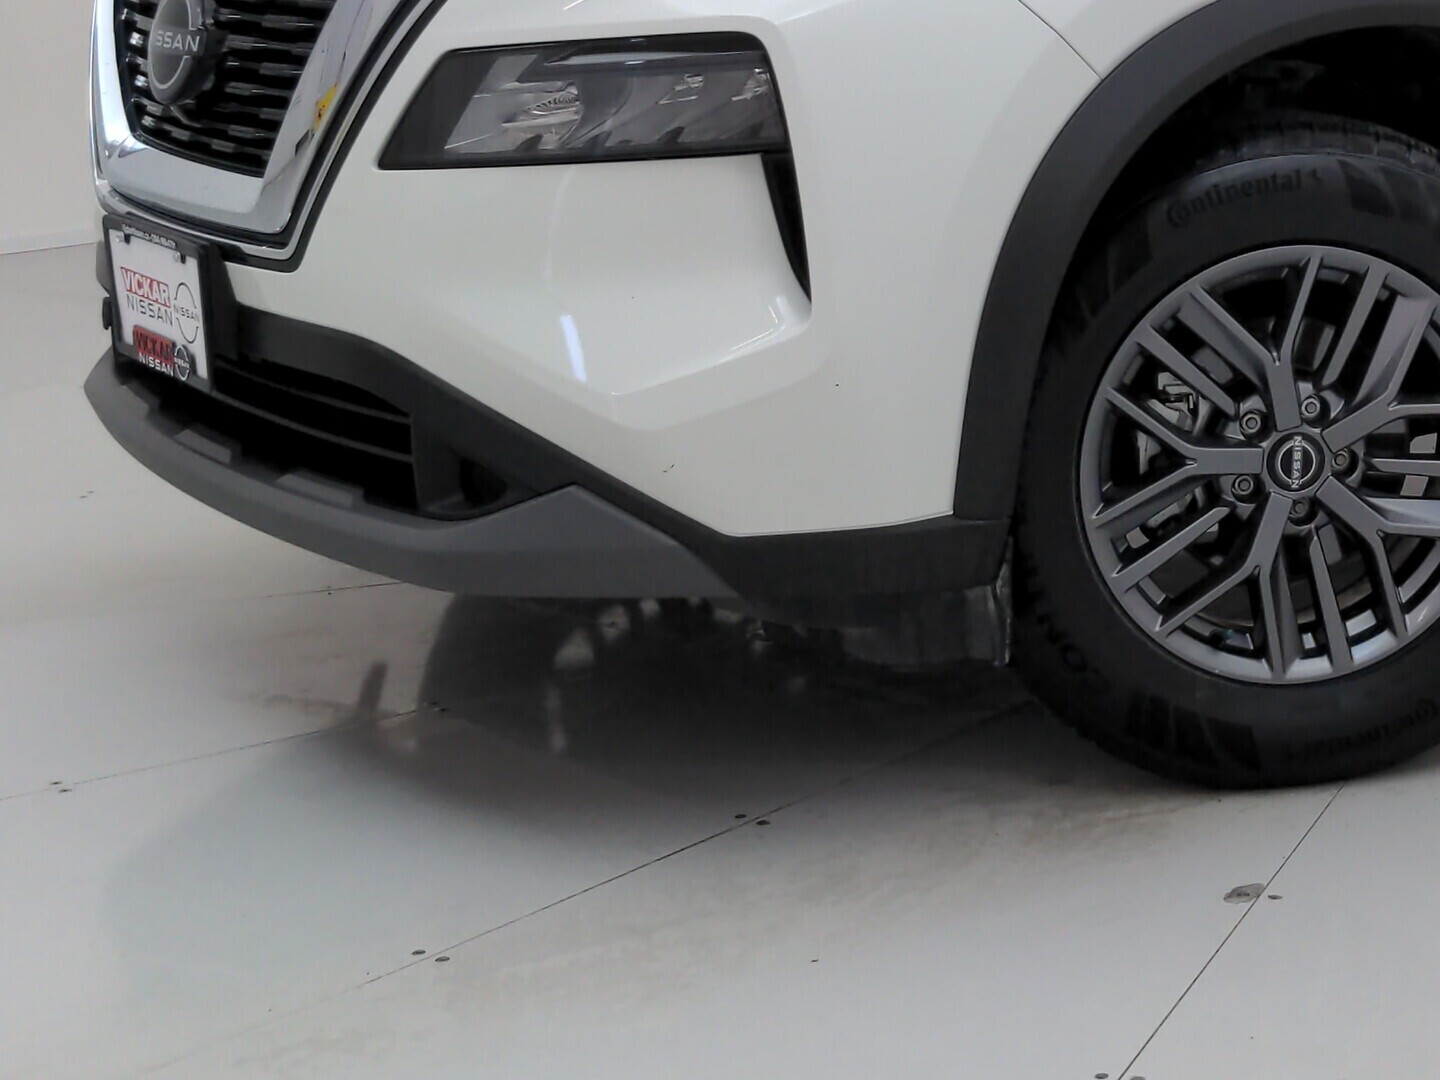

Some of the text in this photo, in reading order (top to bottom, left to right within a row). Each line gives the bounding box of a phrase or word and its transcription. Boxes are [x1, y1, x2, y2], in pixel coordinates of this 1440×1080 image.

[1165, 168, 1302, 228] Continental
[121, 268, 171, 308] VICKAR
[126, 294, 173, 328] NISSAN
[173, 303, 200, 323] NISSAN
[138, 351, 174, 377] NISSAN
[1291, 435, 1303, 488] NISSAN
